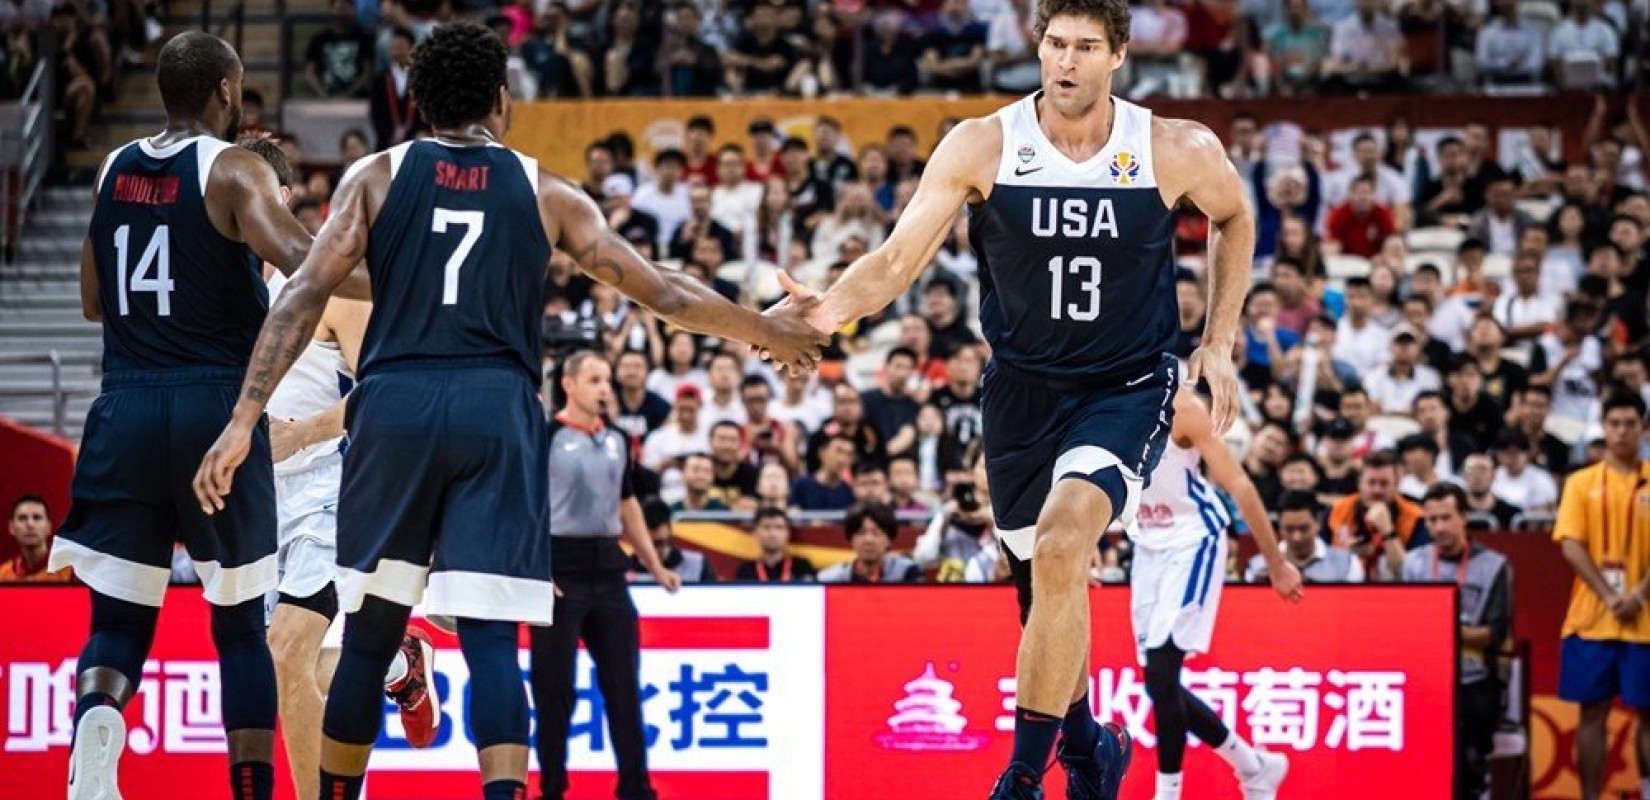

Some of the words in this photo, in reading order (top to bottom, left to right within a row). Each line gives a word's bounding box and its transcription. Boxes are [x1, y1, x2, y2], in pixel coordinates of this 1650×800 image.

[435, 160, 490, 190] SMART
[1032, 198, 1119, 239] USA
[113, 224, 175, 317] 14
[430, 208, 485, 305] 7
[1048, 256, 1102, 321] 13
